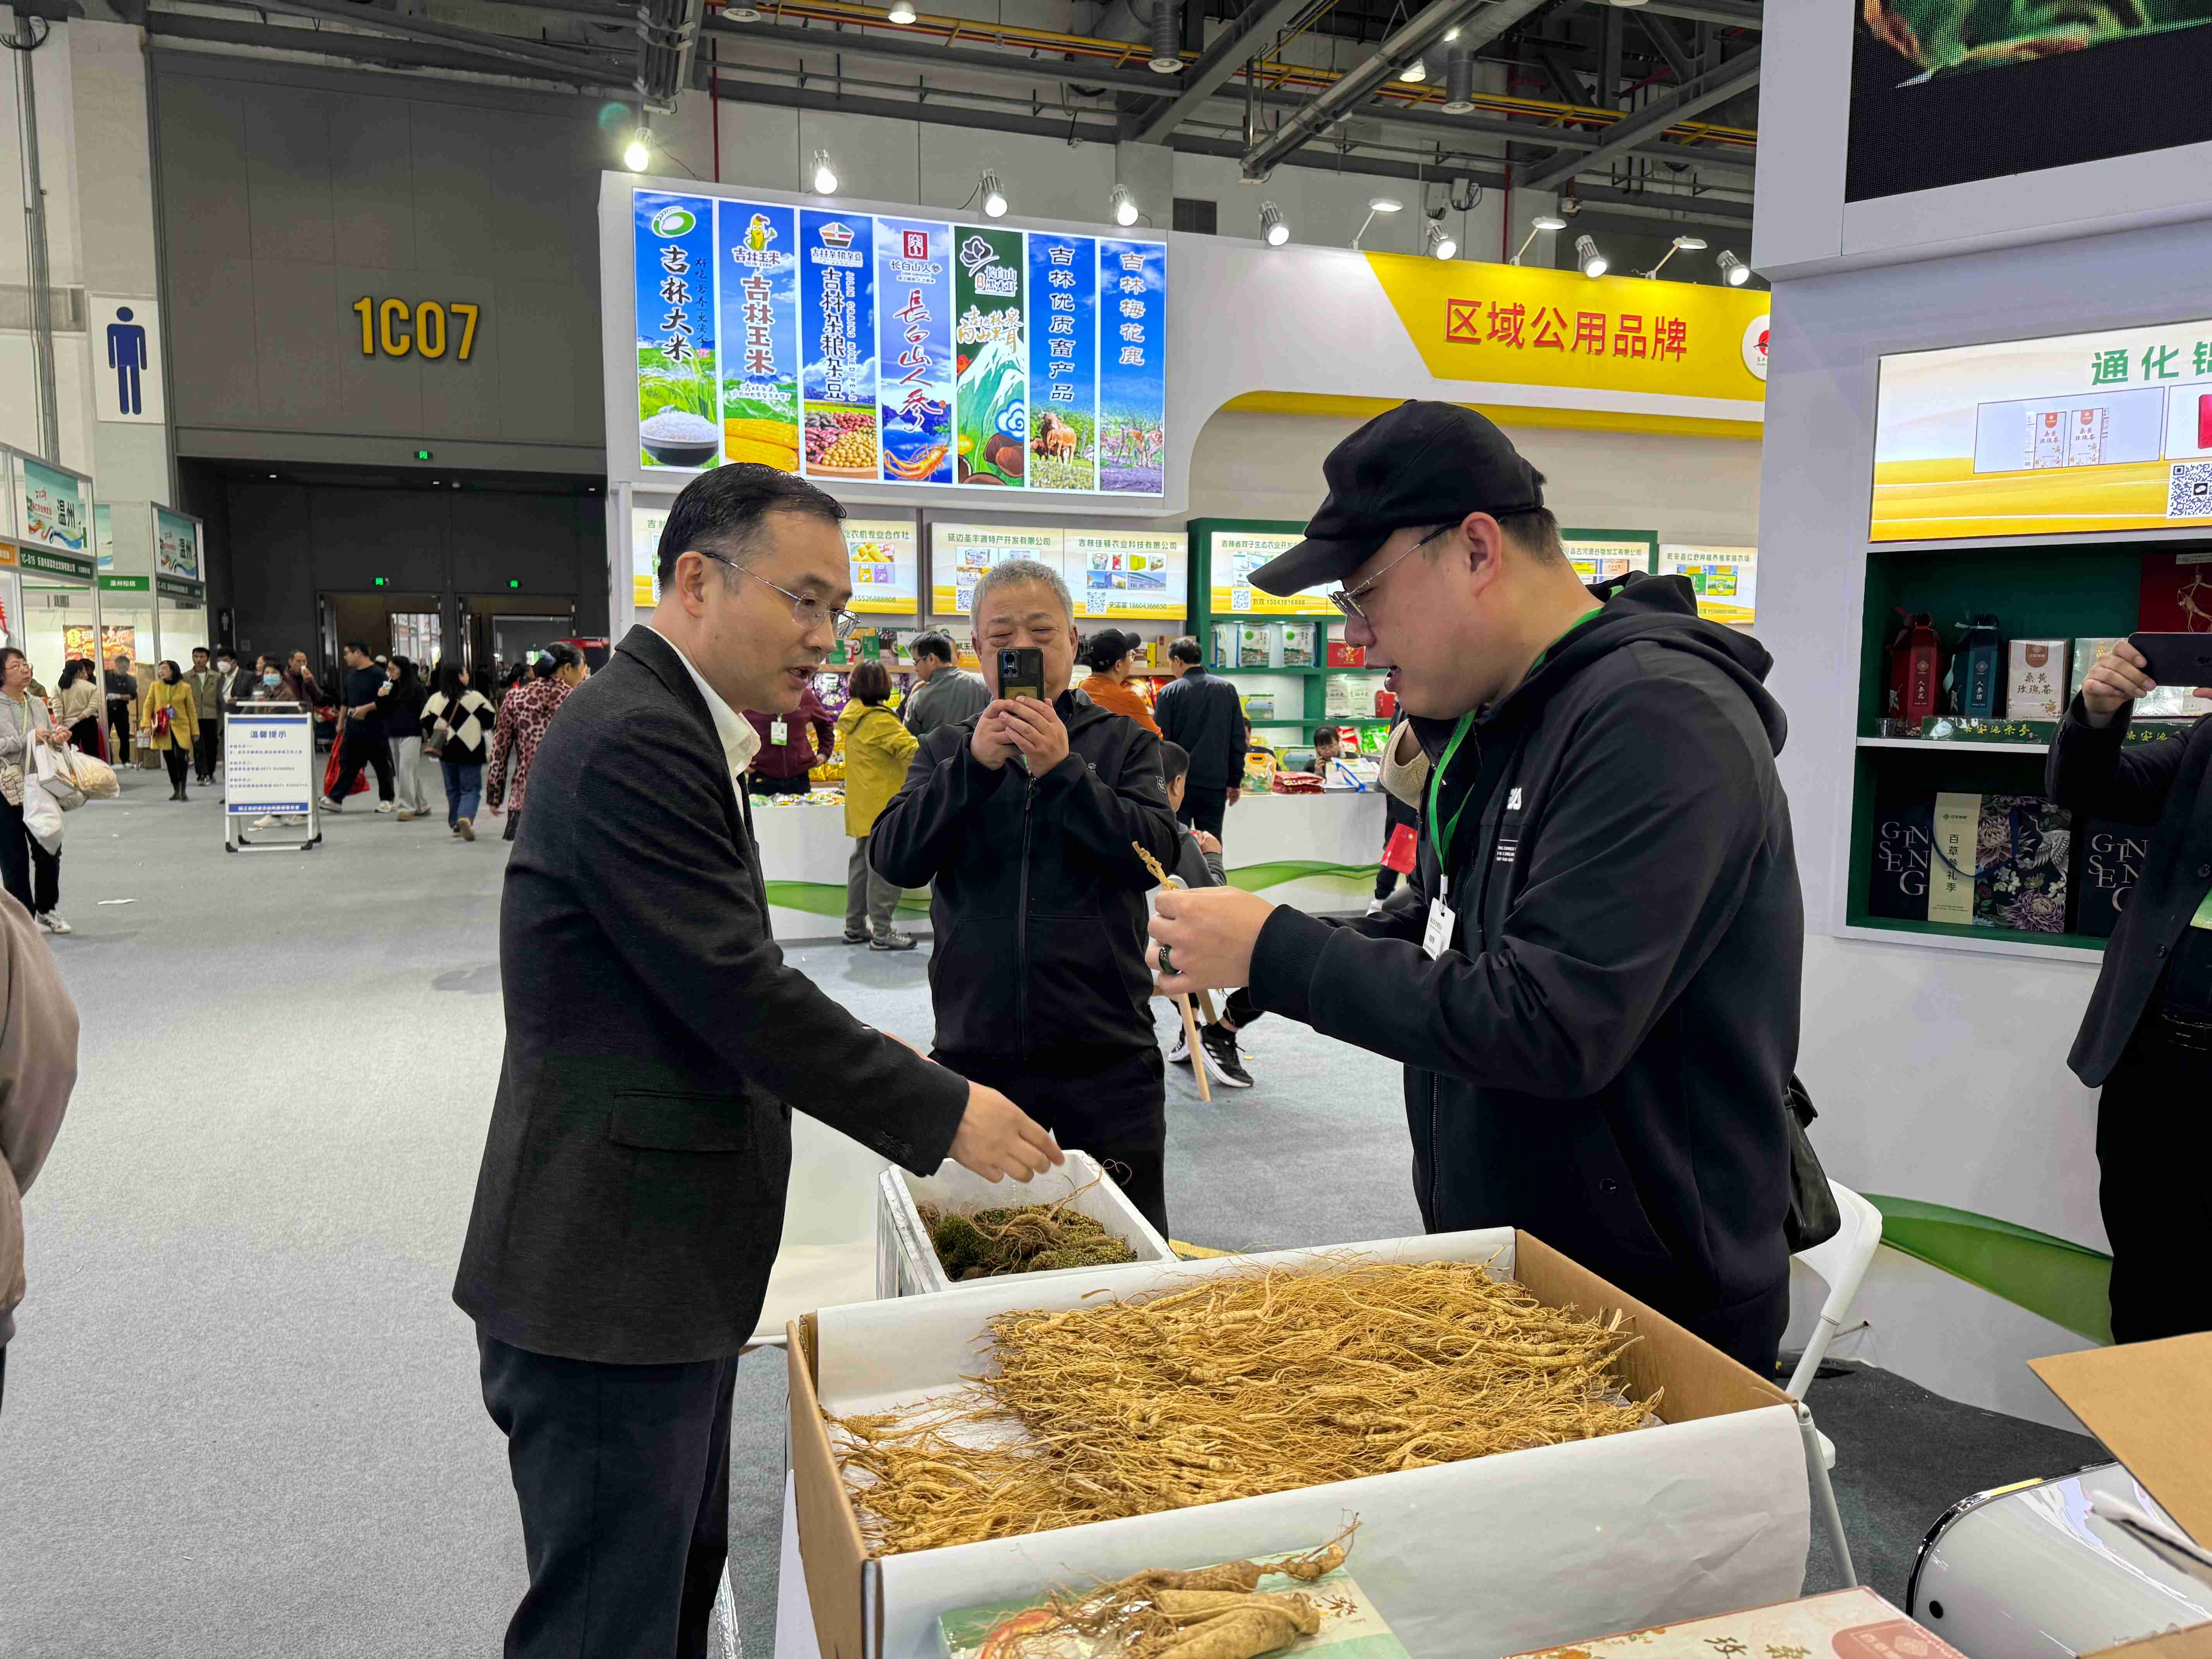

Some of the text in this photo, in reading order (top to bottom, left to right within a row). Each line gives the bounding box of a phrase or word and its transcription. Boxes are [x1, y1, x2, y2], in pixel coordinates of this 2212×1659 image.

[734, 248, 780, 264] 吉林玉米
[812, 249, 861, 261] 吉林杂粮杂豆
[891, 260, 941, 273] 长白山人参
[846, 271, 855, 298] JILIN
[662, 246, 692, 361] 吉林大米
[1120, 251, 1146, 365] 吉林梅花鹿
[353, 296, 479, 360] 1C07
[742, 276, 774, 374] 吉林玉米
[847, 302, 855, 338] GRAINS
[1049, 246, 1075, 401] 吉林优质畜产品
[1445, 298, 1687, 361] 区域公用品牌
[822, 269, 845, 400] 吉林杂粮杂豆
[849, 378, 857, 402] PEAS
[57, 498, 75, 529] 温州
[948, 533, 1051, 546] 延边圣丰源特产开发有限公司
[1079, 538, 1177, 550] 吉林佳顿农业科技有限公司
[1222, 540, 1297, 549] 吉林省双子生态农业开发
[2017, 684, 2053, 694] 玫瑰茶
[2024, 672, 2047, 683] 桑黄
[250, 730, 286, 738] 温馨提示
[1946, 834, 1960, 892] 百草参礼季
